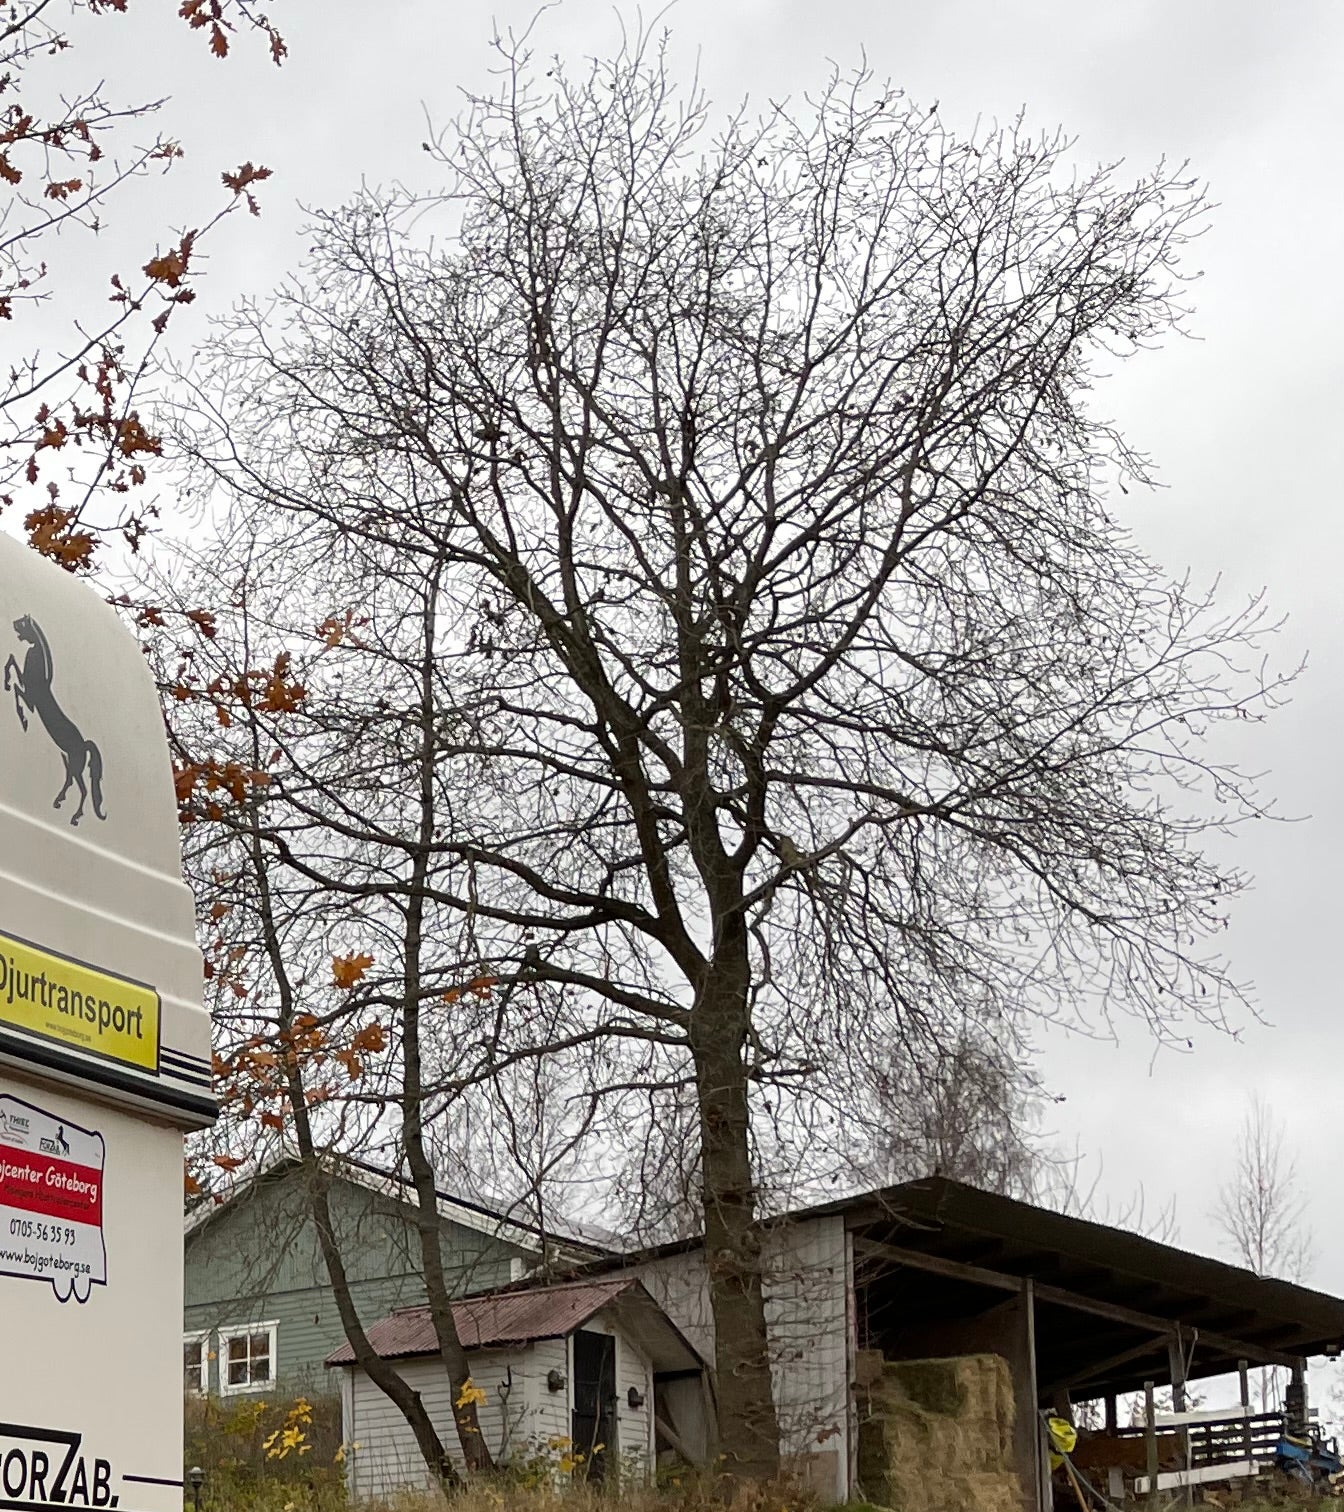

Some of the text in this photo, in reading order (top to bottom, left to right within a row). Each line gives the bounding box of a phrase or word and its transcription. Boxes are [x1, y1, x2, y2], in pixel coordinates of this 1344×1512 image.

[45, 1165, 98, 1203] Göteborg
[10, 1218, 76, 1246] 0705-56 35 93
